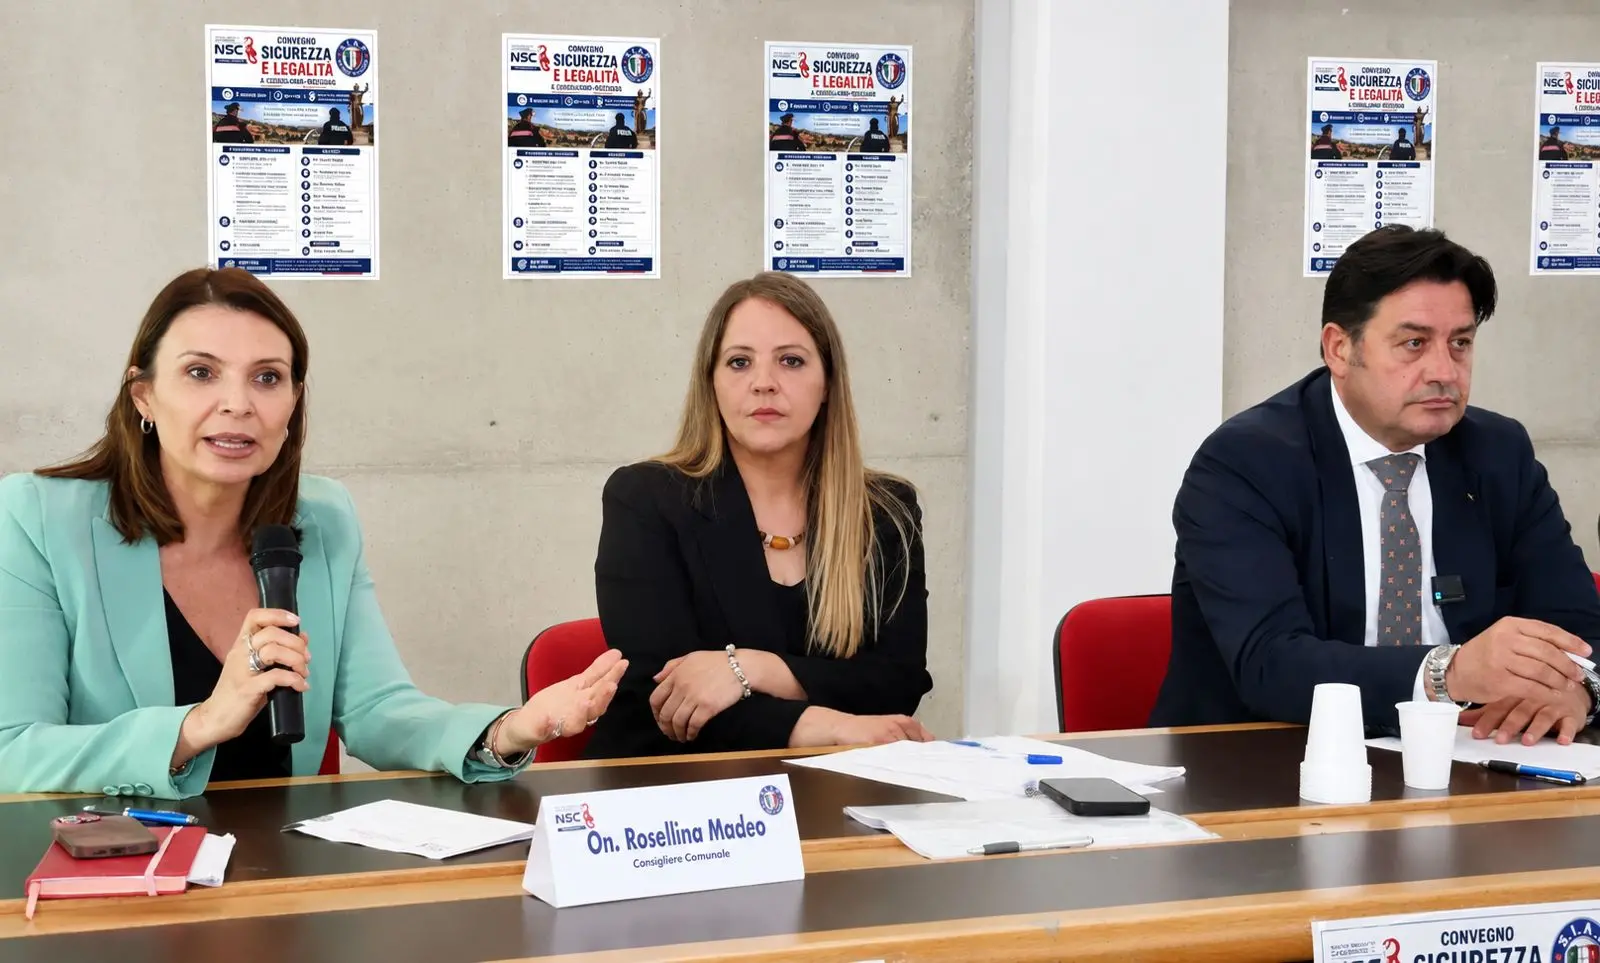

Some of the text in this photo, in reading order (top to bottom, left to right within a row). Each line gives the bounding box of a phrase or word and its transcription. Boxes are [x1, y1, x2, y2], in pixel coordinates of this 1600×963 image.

[277, 36, 316, 45] CONVEGNO
[214, 44, 244, 55] NSC
[261, 46, 332, 61] SICUREZZA
[510, 52, 537, 63] NSC
[553, 53, 618, 68] SICUREZZA
[262, 62, 269, 75] E
[274, 61, 334, 76] LEGALITÀ
[772, 59, 798, 70] NSC
[813, 60, 873, 74] SICUREZZA
[553, 69, 560, 82] E
[564, 68, 620, 84] LEGALITÀ
[813, 75, 820, 88] E
[1315, 74, 1337, 84] NSC
[1350, 75, 1402, 88] SICUREZZA
[1543, 78, 1565, 88] NSC
[1350, 89, 1356, 101] E
[1576, 92, 1583, 104] E
[555, 812, 581, 824] NSC
[587, 813, 766, 855] On. Rosellina Madeo
[633, 855, 683, 869] Consigliere
[1441, 926, 1514, 946] CONVEGNO
